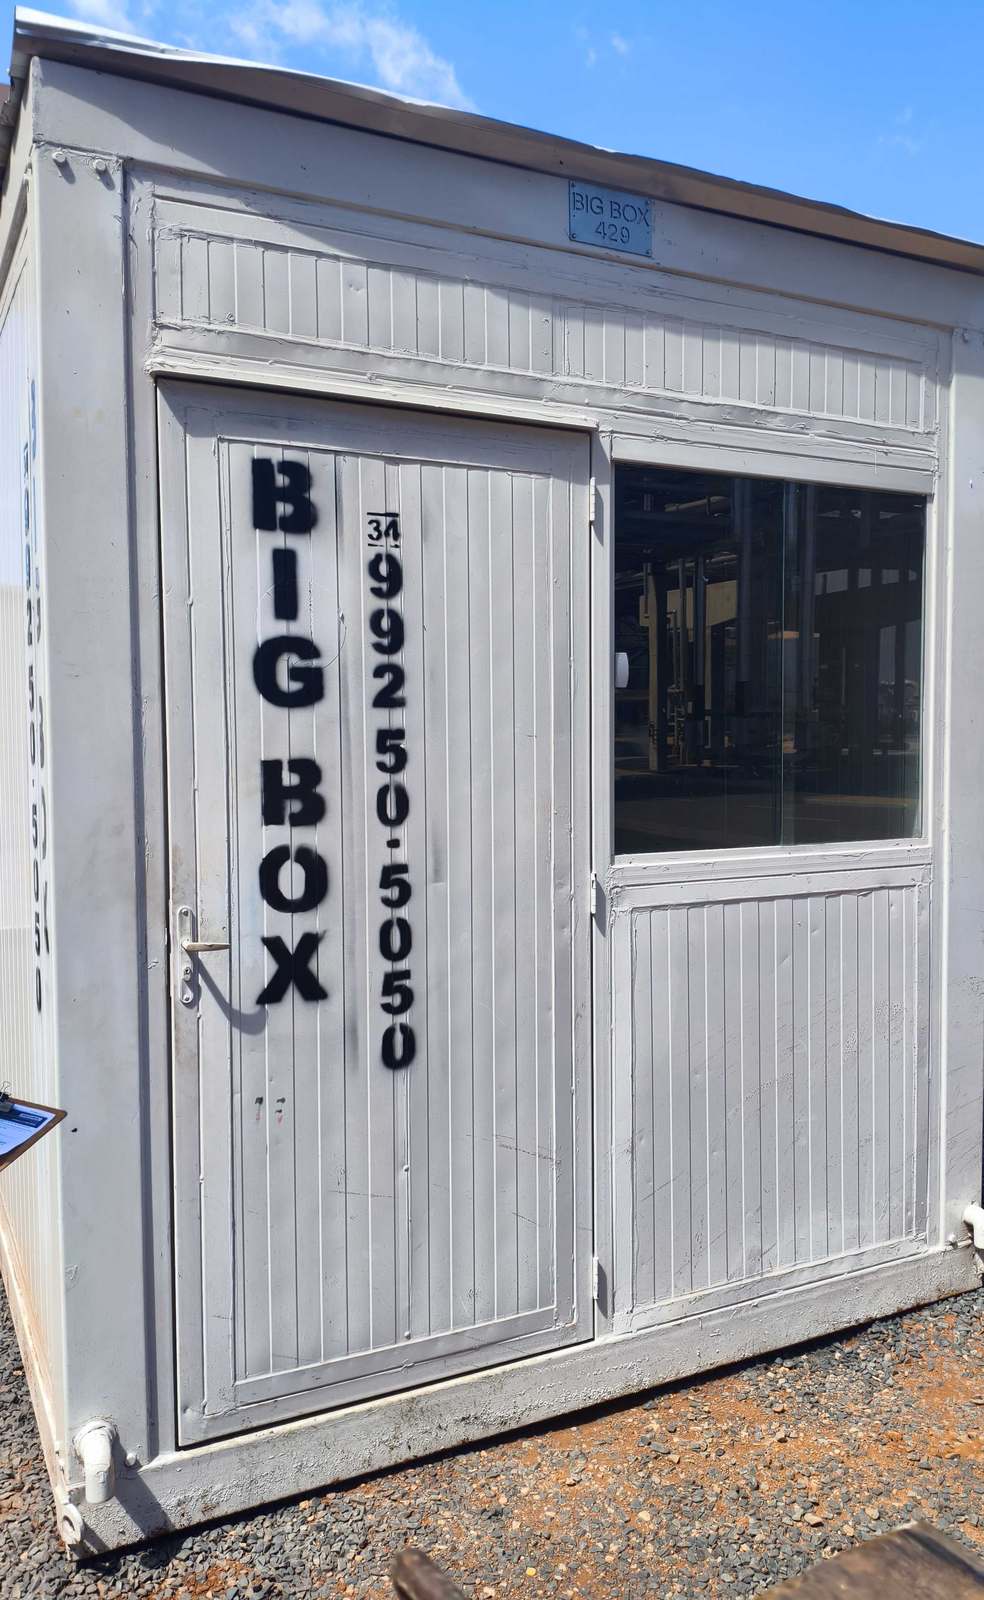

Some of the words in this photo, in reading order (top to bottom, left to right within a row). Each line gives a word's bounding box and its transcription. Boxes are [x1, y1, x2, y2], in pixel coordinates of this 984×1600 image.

[573, 191, 604, 215] BIG
[610, 200, 650, 227] BOX
[595, 221, 630, 244] 429
[251, 457, 325, 708] BIG
[256, 757, 329, 1005] BOX
